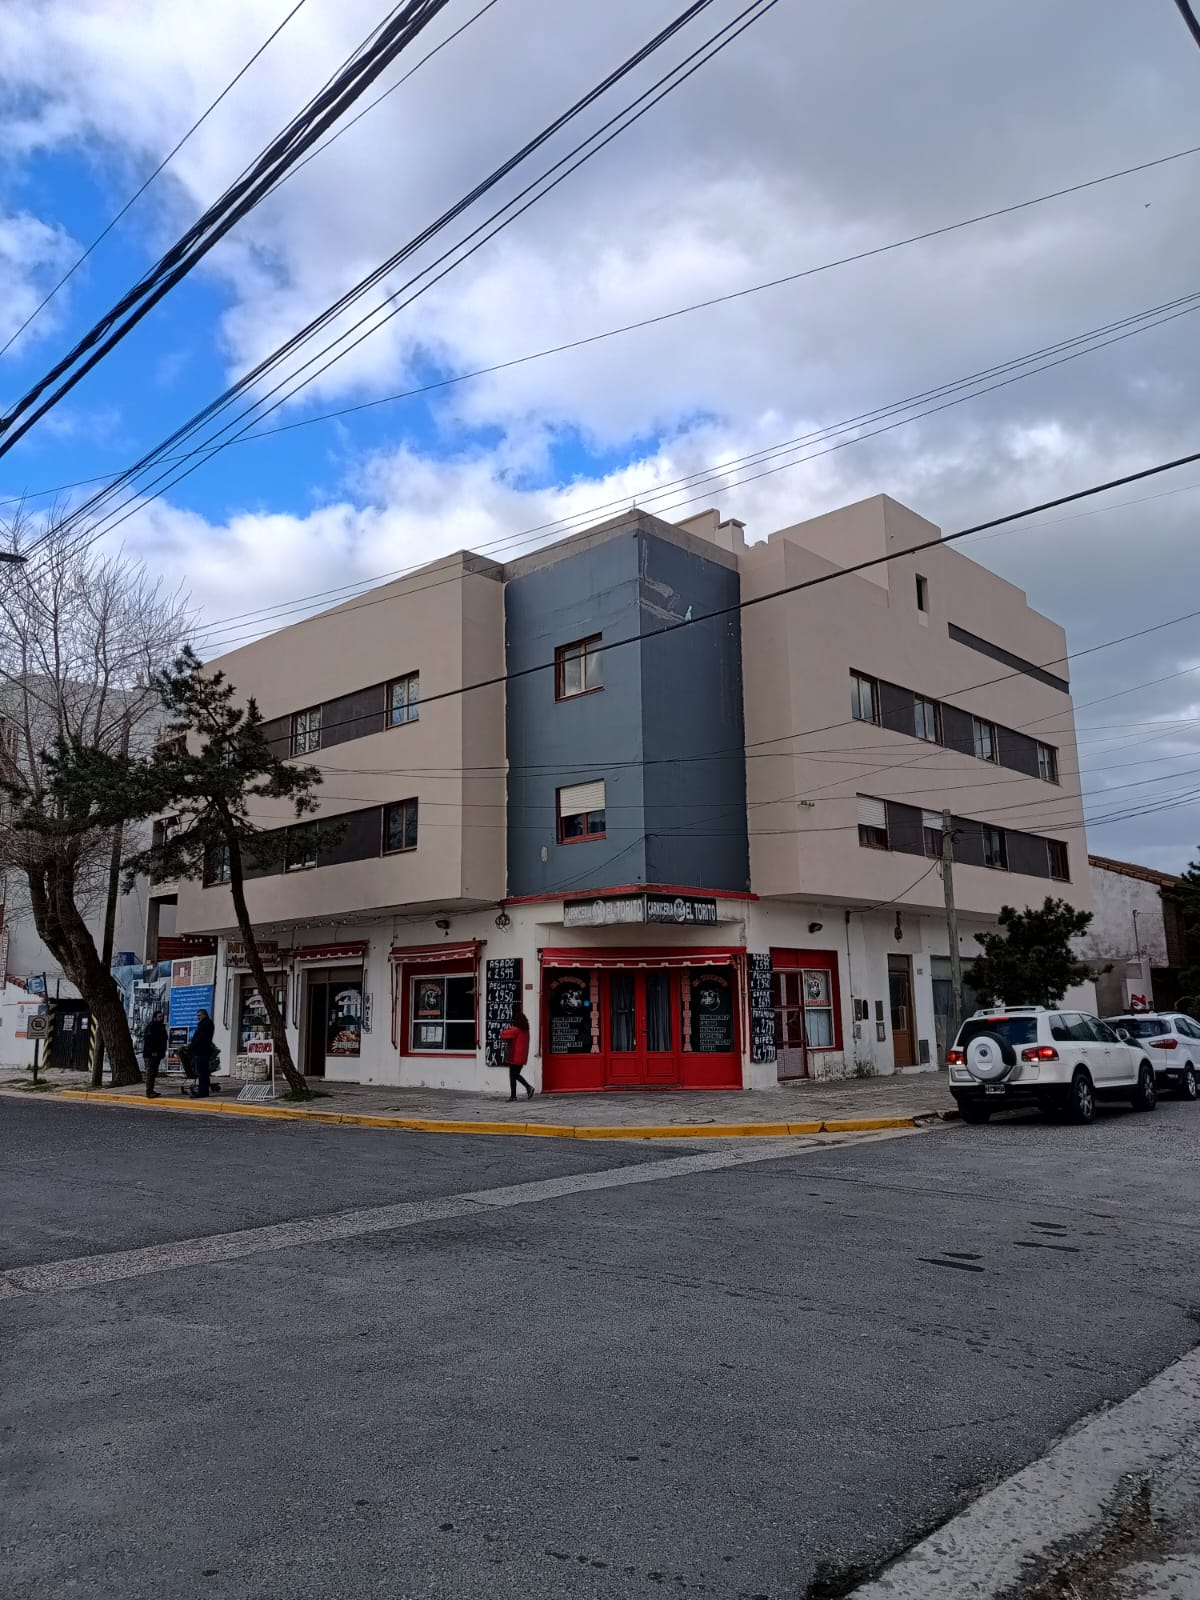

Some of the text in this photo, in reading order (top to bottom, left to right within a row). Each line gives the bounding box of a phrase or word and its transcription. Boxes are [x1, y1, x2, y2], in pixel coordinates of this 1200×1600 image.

[647, 902, 716, 921] CARNICERIA EL TORITO
[489, 959, 515, 968] ASADO
[494, 968, 514, 979] 2599
[489, 982, 517, 990] PECHITO
[495, 990, 514, 1002] 1950
[497, 1009, 513, 1019] 1699
